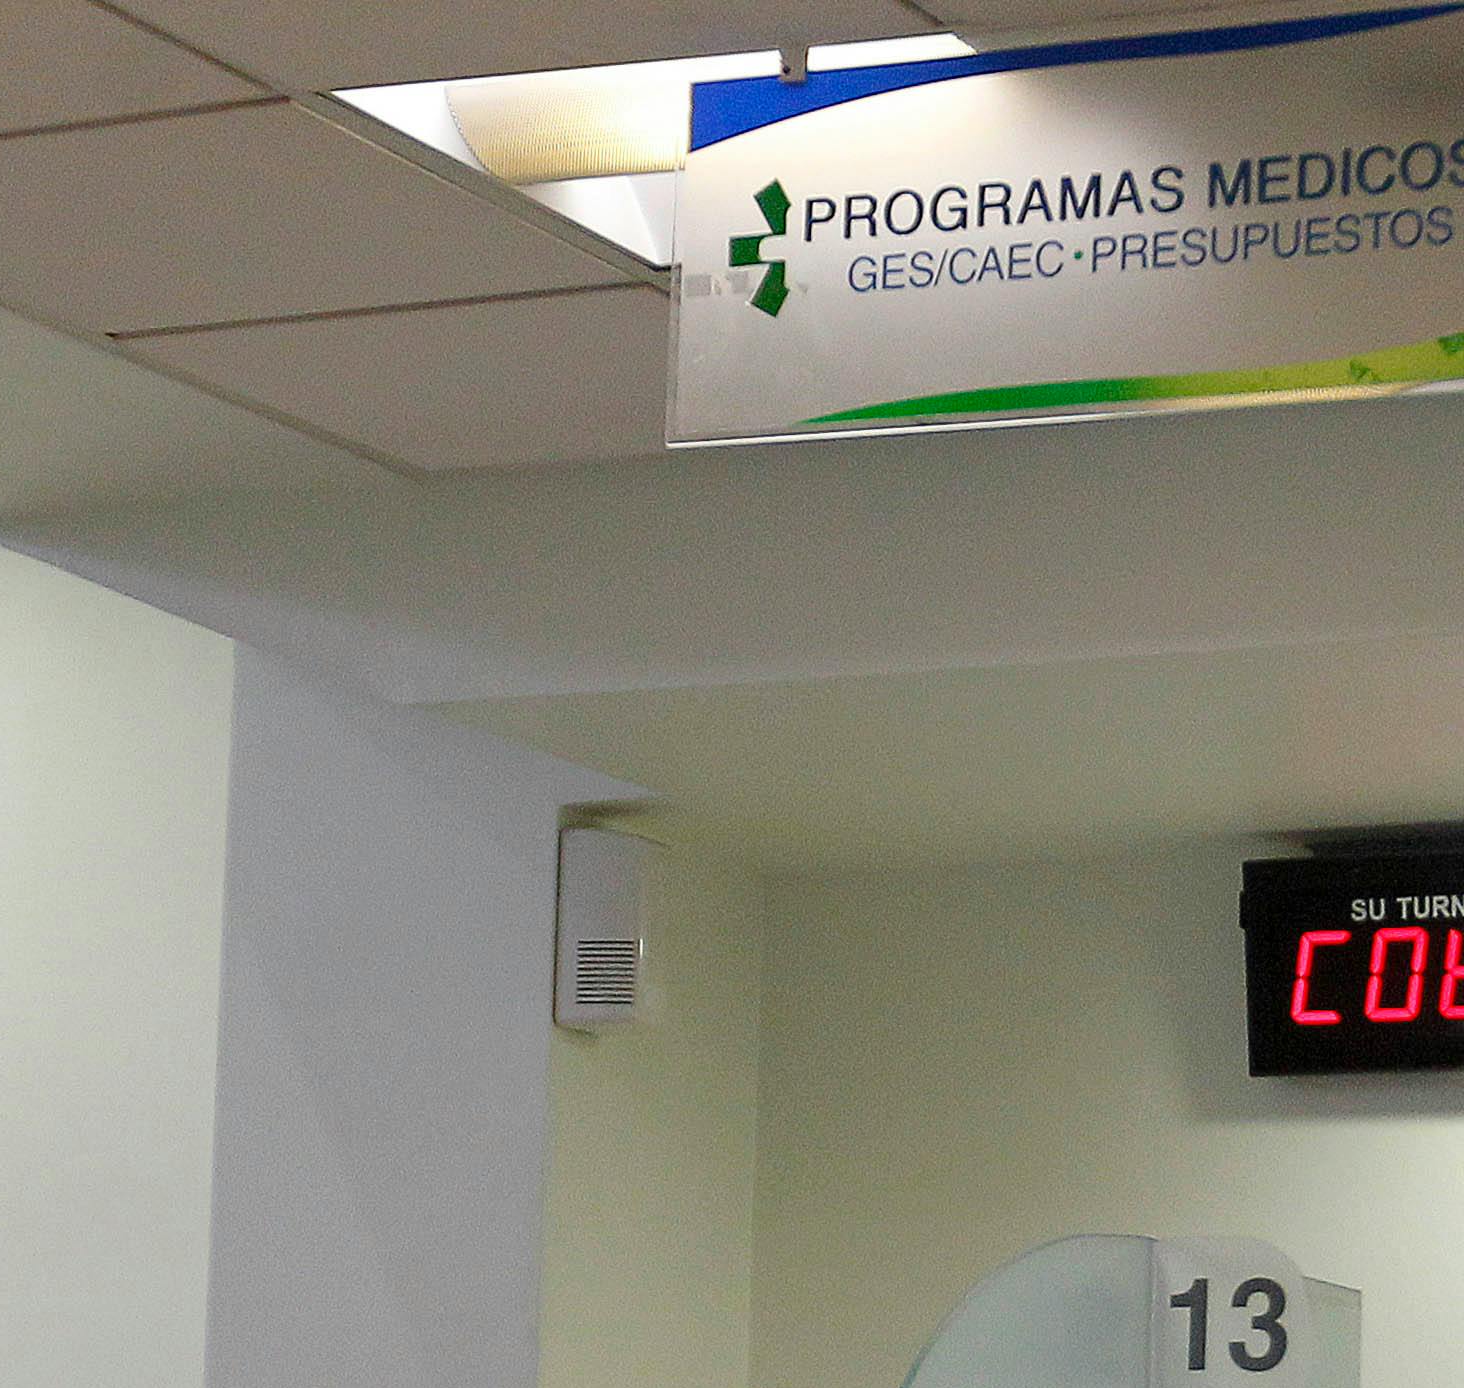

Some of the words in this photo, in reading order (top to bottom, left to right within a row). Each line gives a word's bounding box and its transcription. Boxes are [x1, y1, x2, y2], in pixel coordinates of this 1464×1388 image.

[802, 166, 1186, 243] PROGRAMAS
[1090, 206, 1455, 274] PRESUPUESTOS
[1350, 897, 1387, 922] SU
[1168, 1276, 1289, 1372] 13
